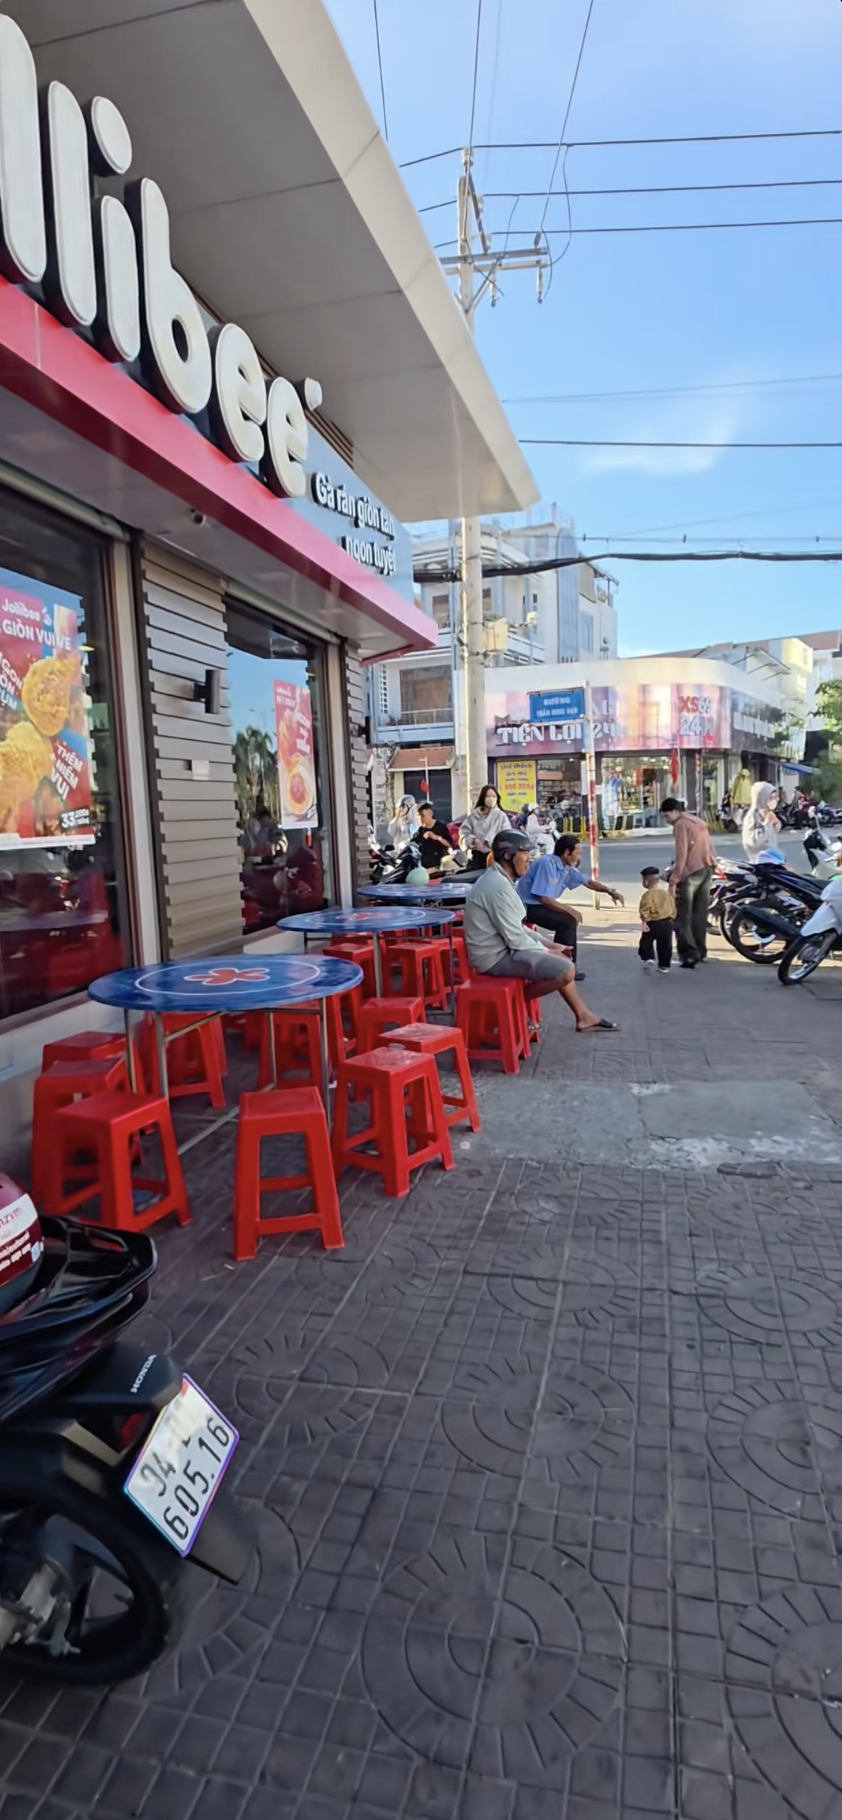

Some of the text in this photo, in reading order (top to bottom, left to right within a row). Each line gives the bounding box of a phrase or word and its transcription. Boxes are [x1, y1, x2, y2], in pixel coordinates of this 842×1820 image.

[315, 471, 335, 509] Gà
[336, 484, 356, 517] rán
[2, 598, 41, 622] Jollibee
[2, 618, 34, 642] GIÒN
[497, 724, 546, 747] TIỆN
[61, 812, 75, 829] 33
[130, 1354, 157, 1393] HONDA
[163, 1417, 230, 1540] 605.16
